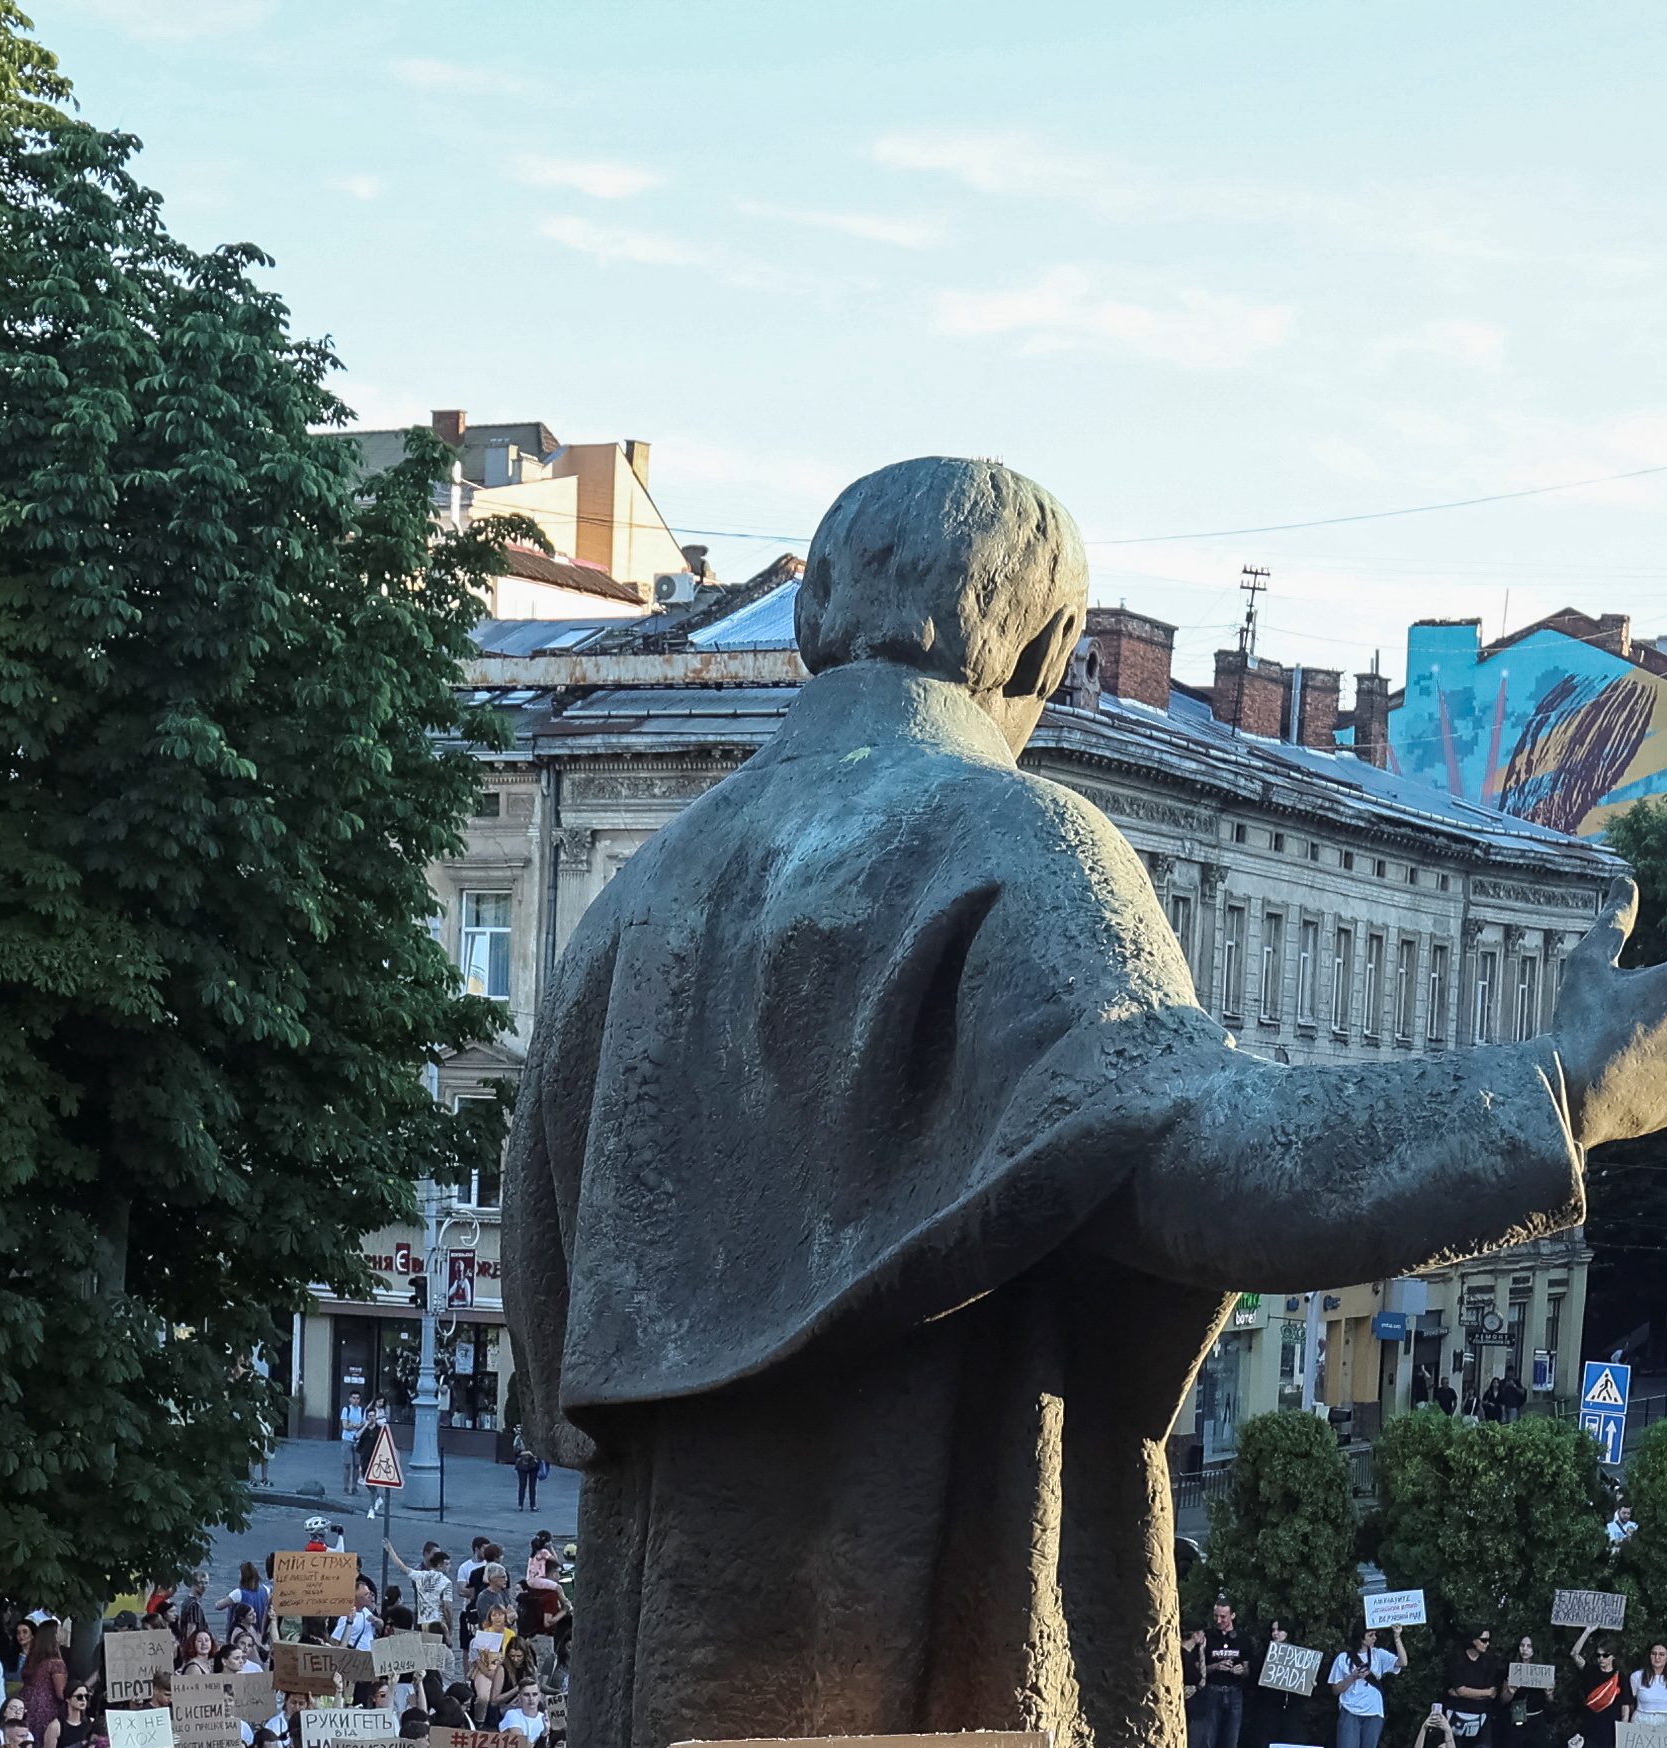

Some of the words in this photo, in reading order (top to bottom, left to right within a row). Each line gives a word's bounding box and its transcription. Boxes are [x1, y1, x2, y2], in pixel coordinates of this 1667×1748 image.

[277, 1555, 306, 1570] МІЙ
[311, 1554, 353, 1569] СТРАХ
[1267, 1663, 1307, 1689] ЗРАДА
[306, 1714, 348, 1729] РУКИ
[352, 1714, 393, 1730] ГЕТЬ
